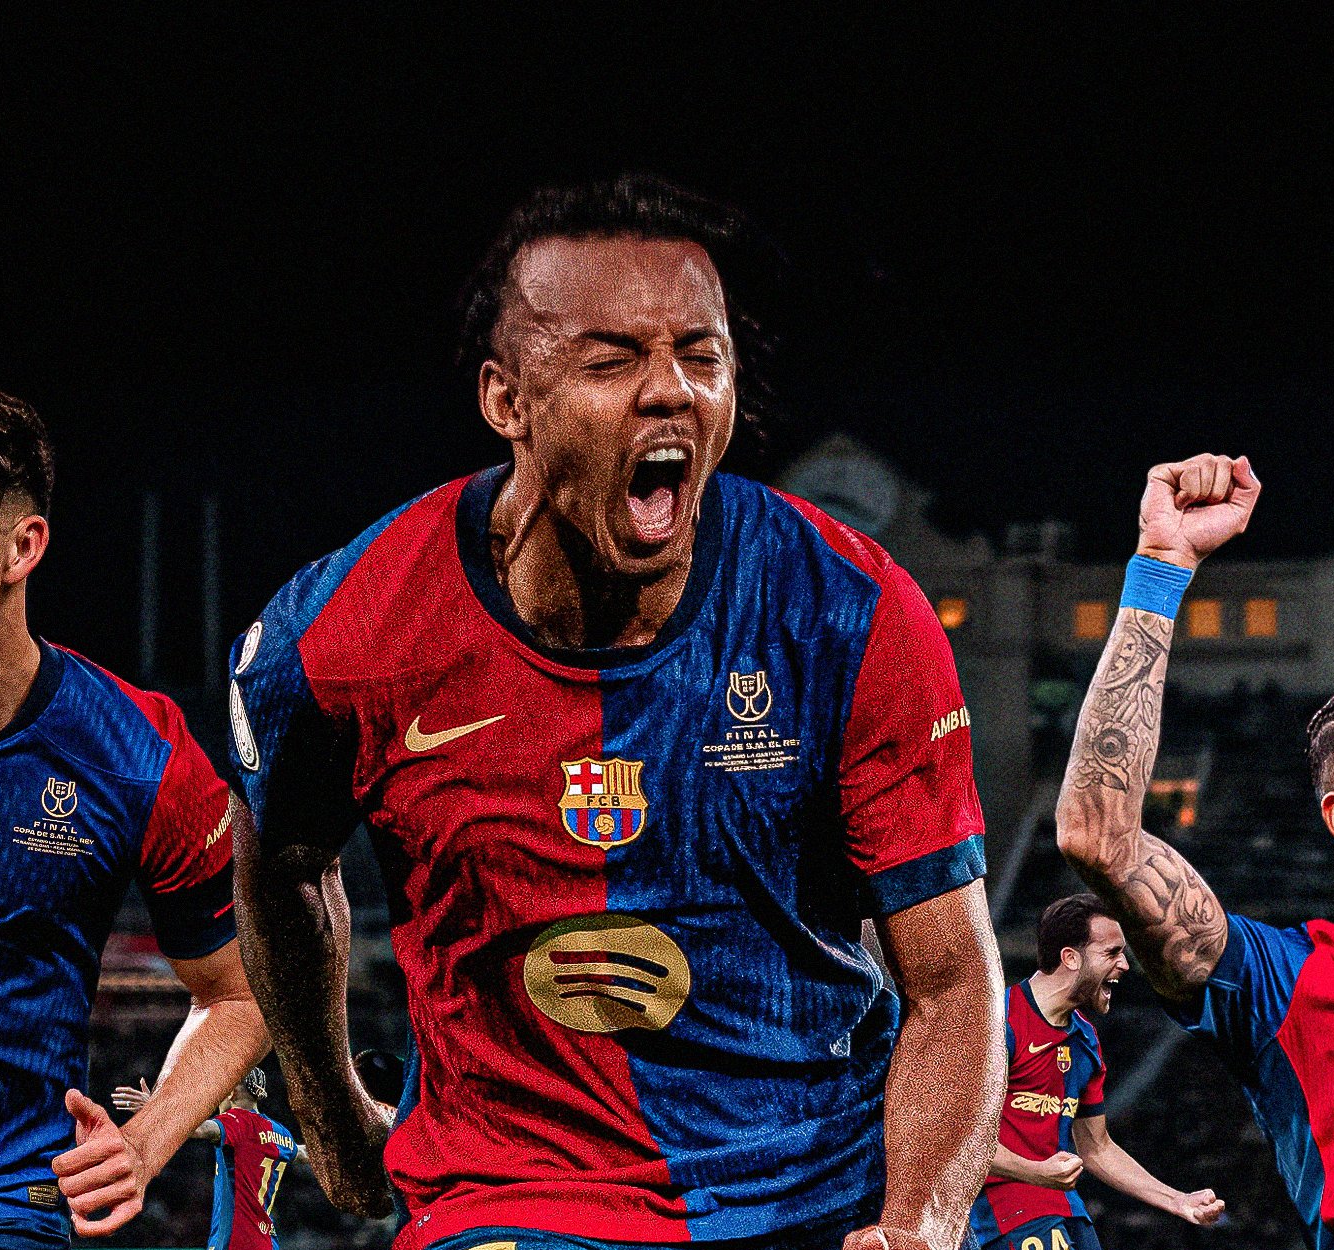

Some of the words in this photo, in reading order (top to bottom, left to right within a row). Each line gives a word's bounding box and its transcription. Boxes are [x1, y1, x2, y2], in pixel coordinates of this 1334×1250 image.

[726, 729, 779, 740] FINAL
[703, 744, 730, 752] COPA
[731, 743, 744, 751] DE
[586, 796, 620, 806] FCB
[33, 821, 78, 834] FINAL
[13, 826, 35, 836] COPA
[79, 837, 95, 845] REY
[257, 1156, 287, 1217] 11
